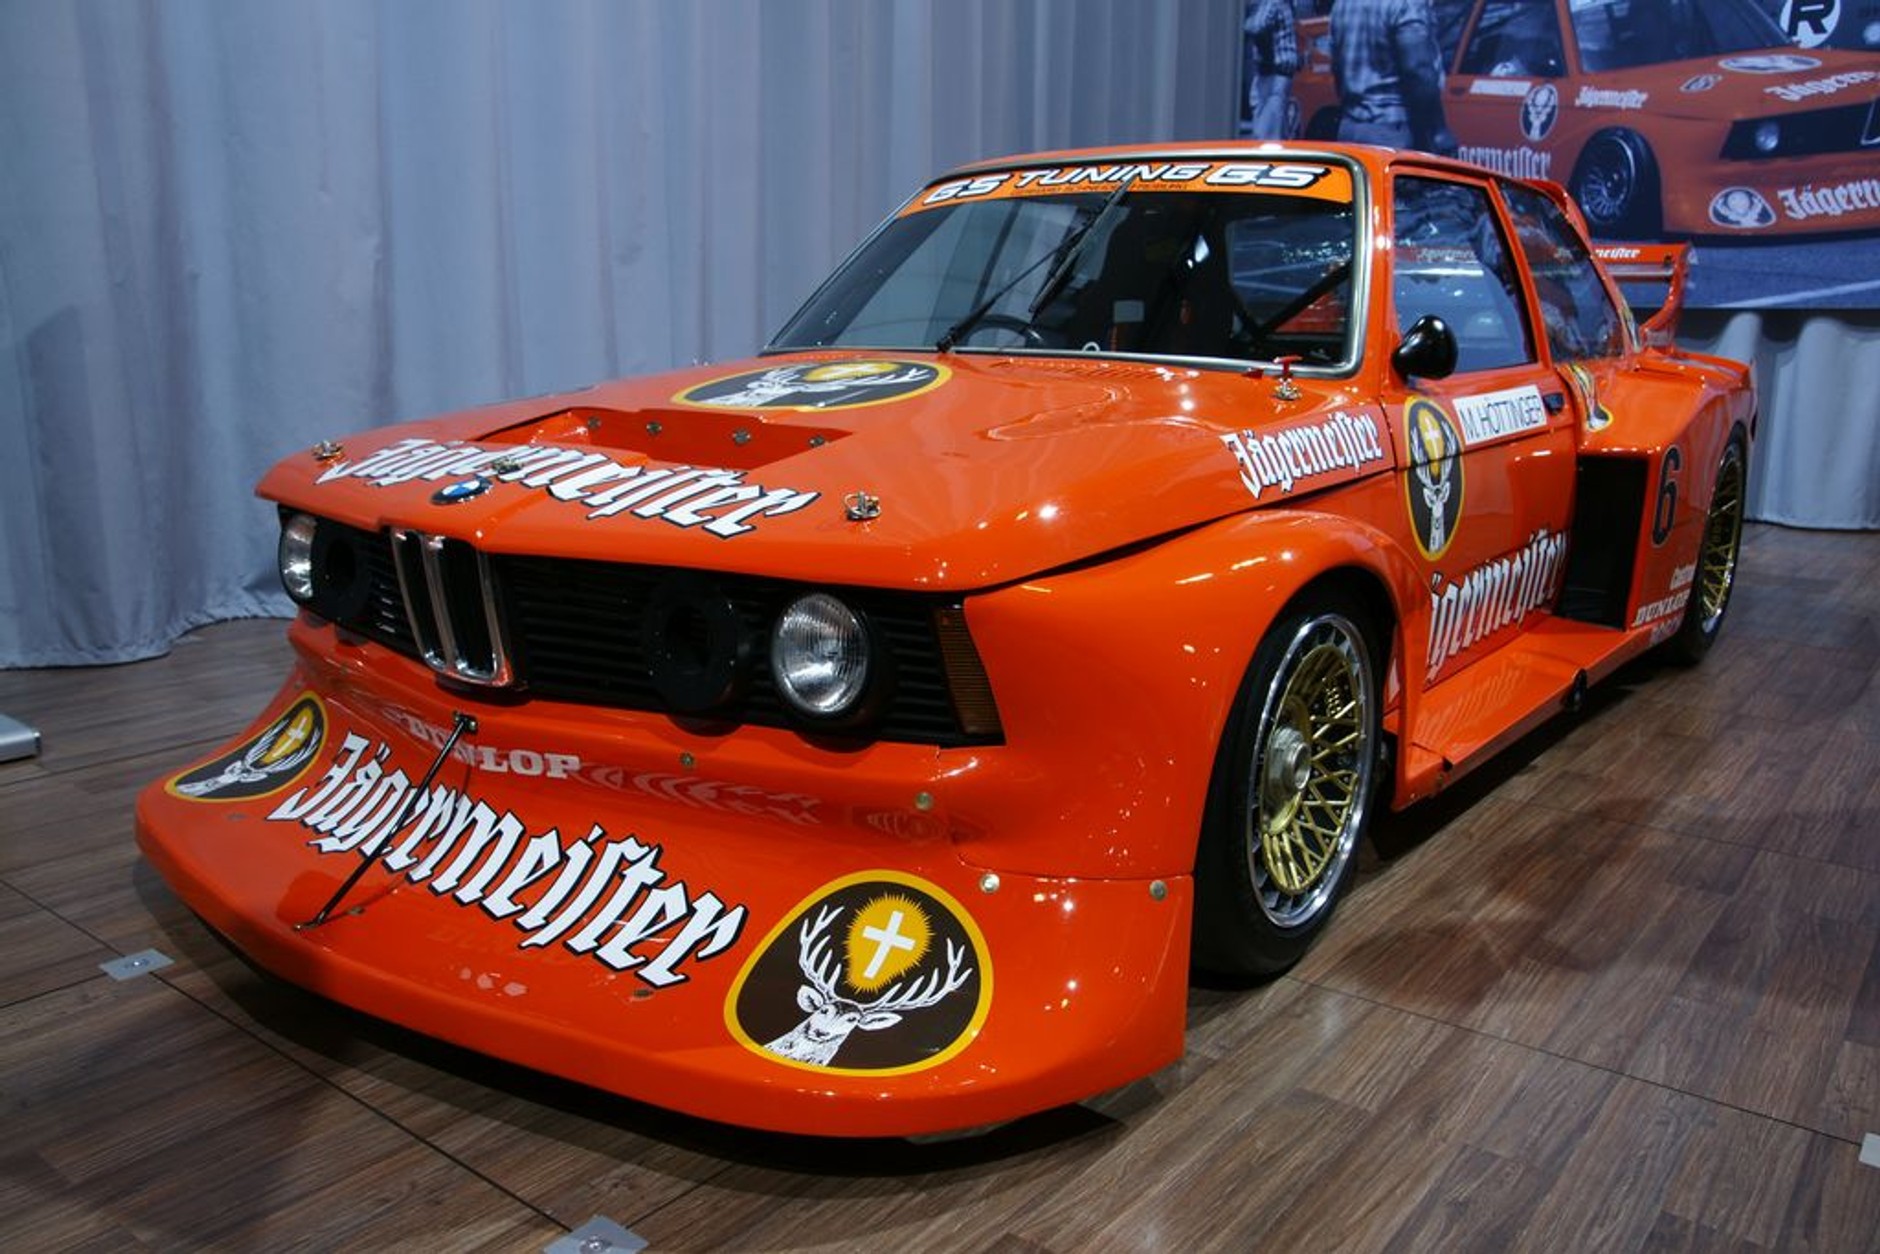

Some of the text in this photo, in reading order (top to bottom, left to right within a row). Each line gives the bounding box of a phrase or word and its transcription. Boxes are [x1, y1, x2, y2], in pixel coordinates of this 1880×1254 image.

[922, 172, 1013, 206] GS
[1014, 163, 1208, 188] TUNING
[1202, 162, 1331, 189] GS
[1218, 411, 1383, 499] Jägermeister
[1651, 444, 1683, 549] 6
[408, 718, 582, 780] DUNLOP
